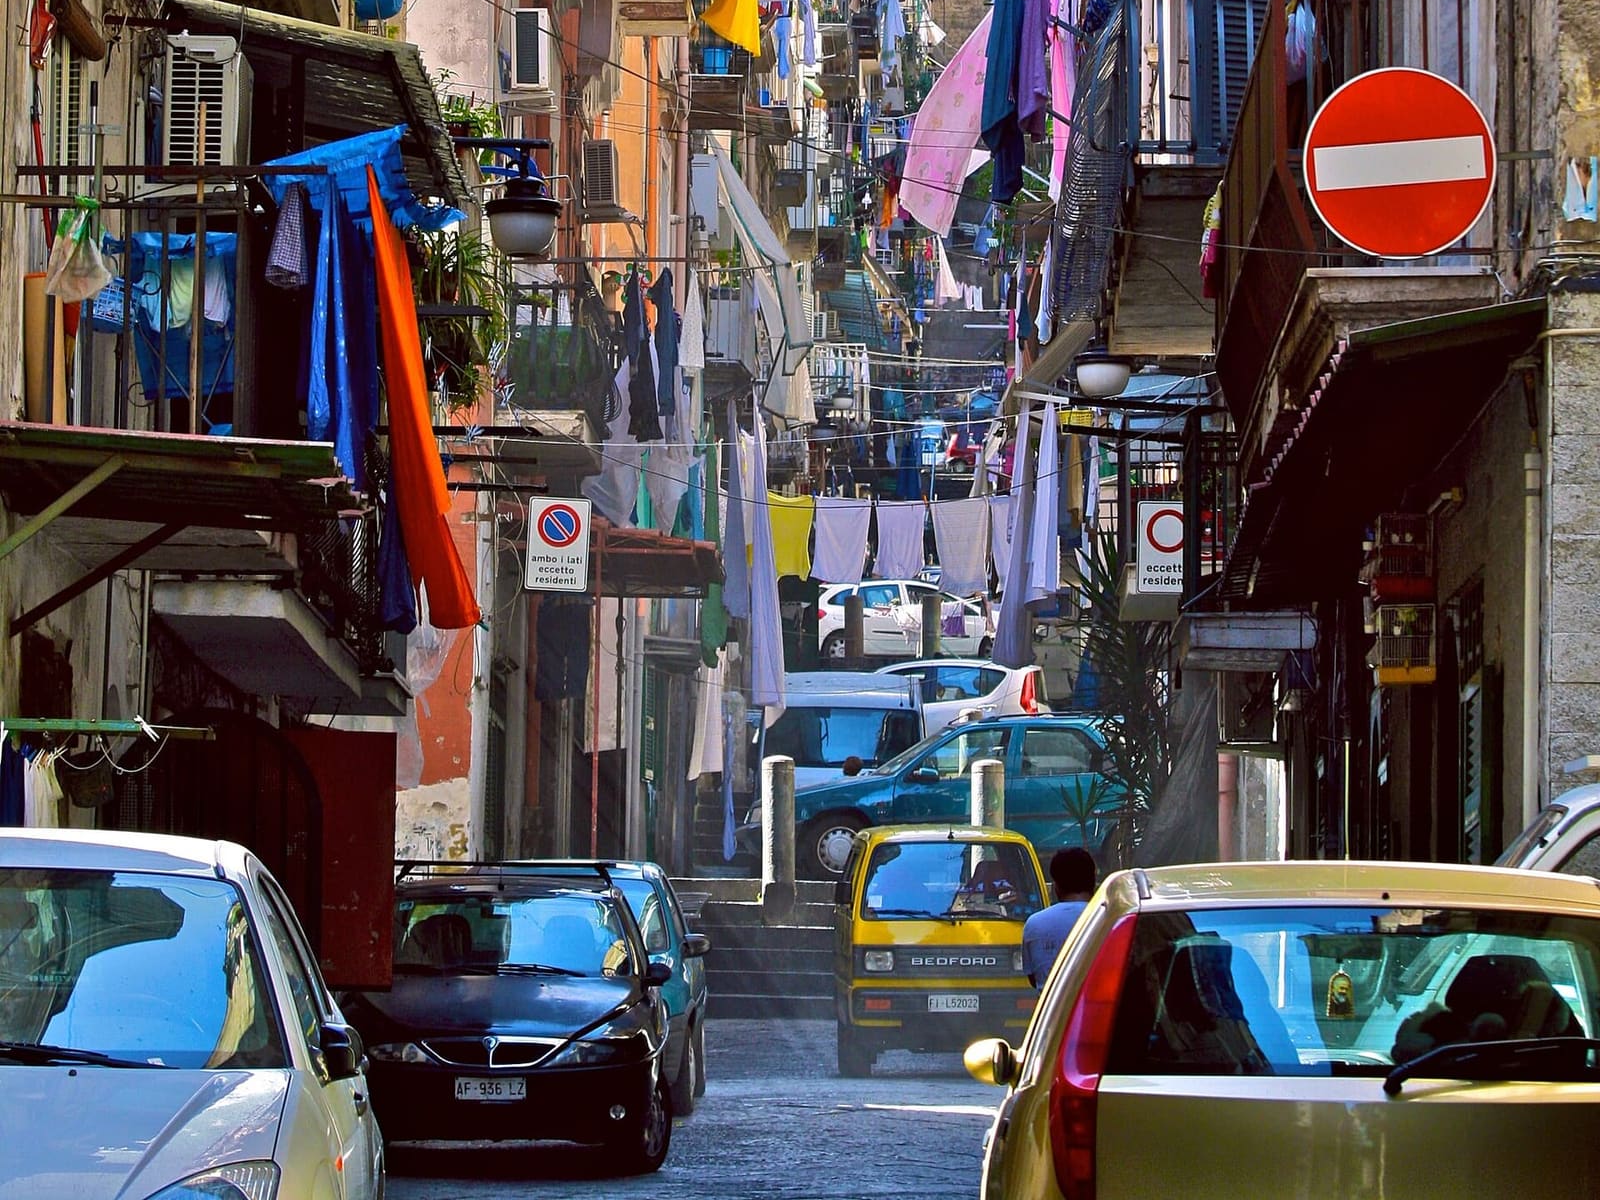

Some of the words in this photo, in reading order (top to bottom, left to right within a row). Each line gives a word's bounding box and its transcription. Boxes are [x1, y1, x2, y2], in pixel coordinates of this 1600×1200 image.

[531, 554, 558, 563] ambo
[560, 555, 564, 564] i
[567, 555, 583, 565] lati
[538, 566, 575, 575] eccetto
[1146, 563, 1182, 573] eccett
[535, 575, 577, 585] residenti
[1142, 575, 1183, 585] residen
[911, 957, 996, 966] BEDFORD
[508, 1081, 525, 1096] LZ
